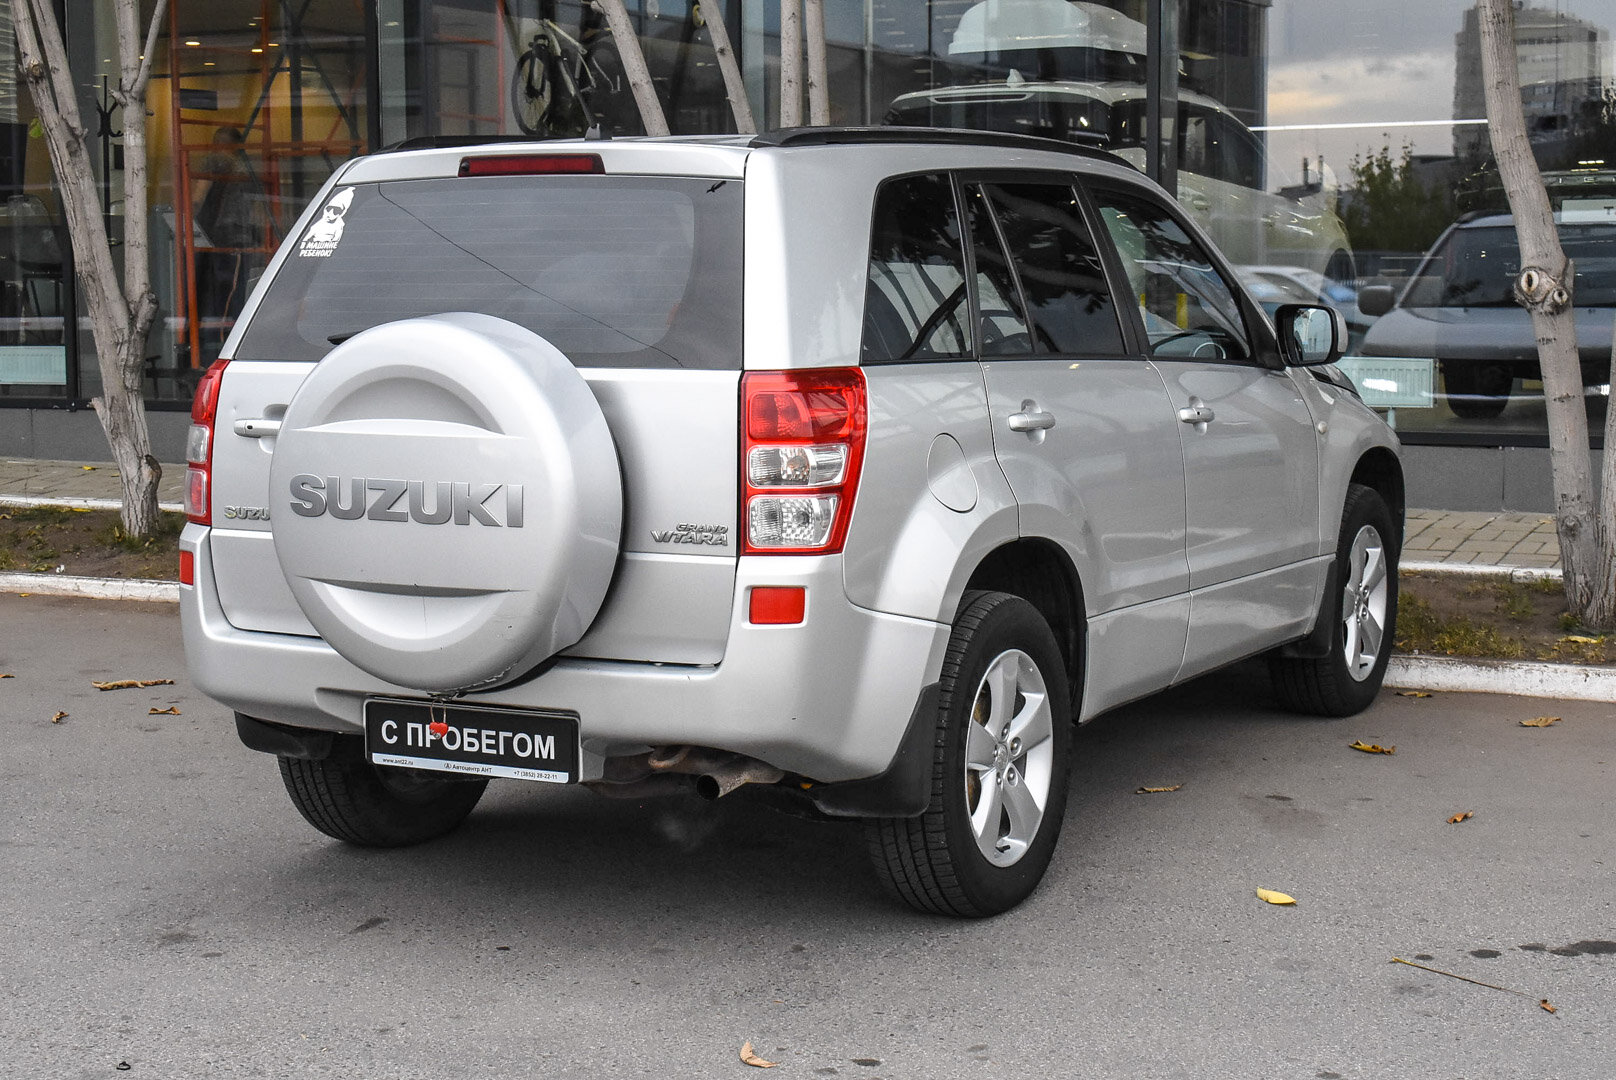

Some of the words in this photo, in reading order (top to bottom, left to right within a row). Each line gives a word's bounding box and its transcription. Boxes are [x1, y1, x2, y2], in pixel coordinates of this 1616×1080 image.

[300, 241, 306, 249] В
[306, 241, 338, 249] МАШИНЕ
[299, 249, 333, 257] РЕБЕНОК!
[289, 473, 524, 528] SUZUKI
[224, 505, 271, 521] SUZU
[676, 523, 728, 534] GRAND
[650, 530, 728, 546] VITARA
[381, 720, 398, 744] С
[452, 764, 480, 773] Автоцентр
